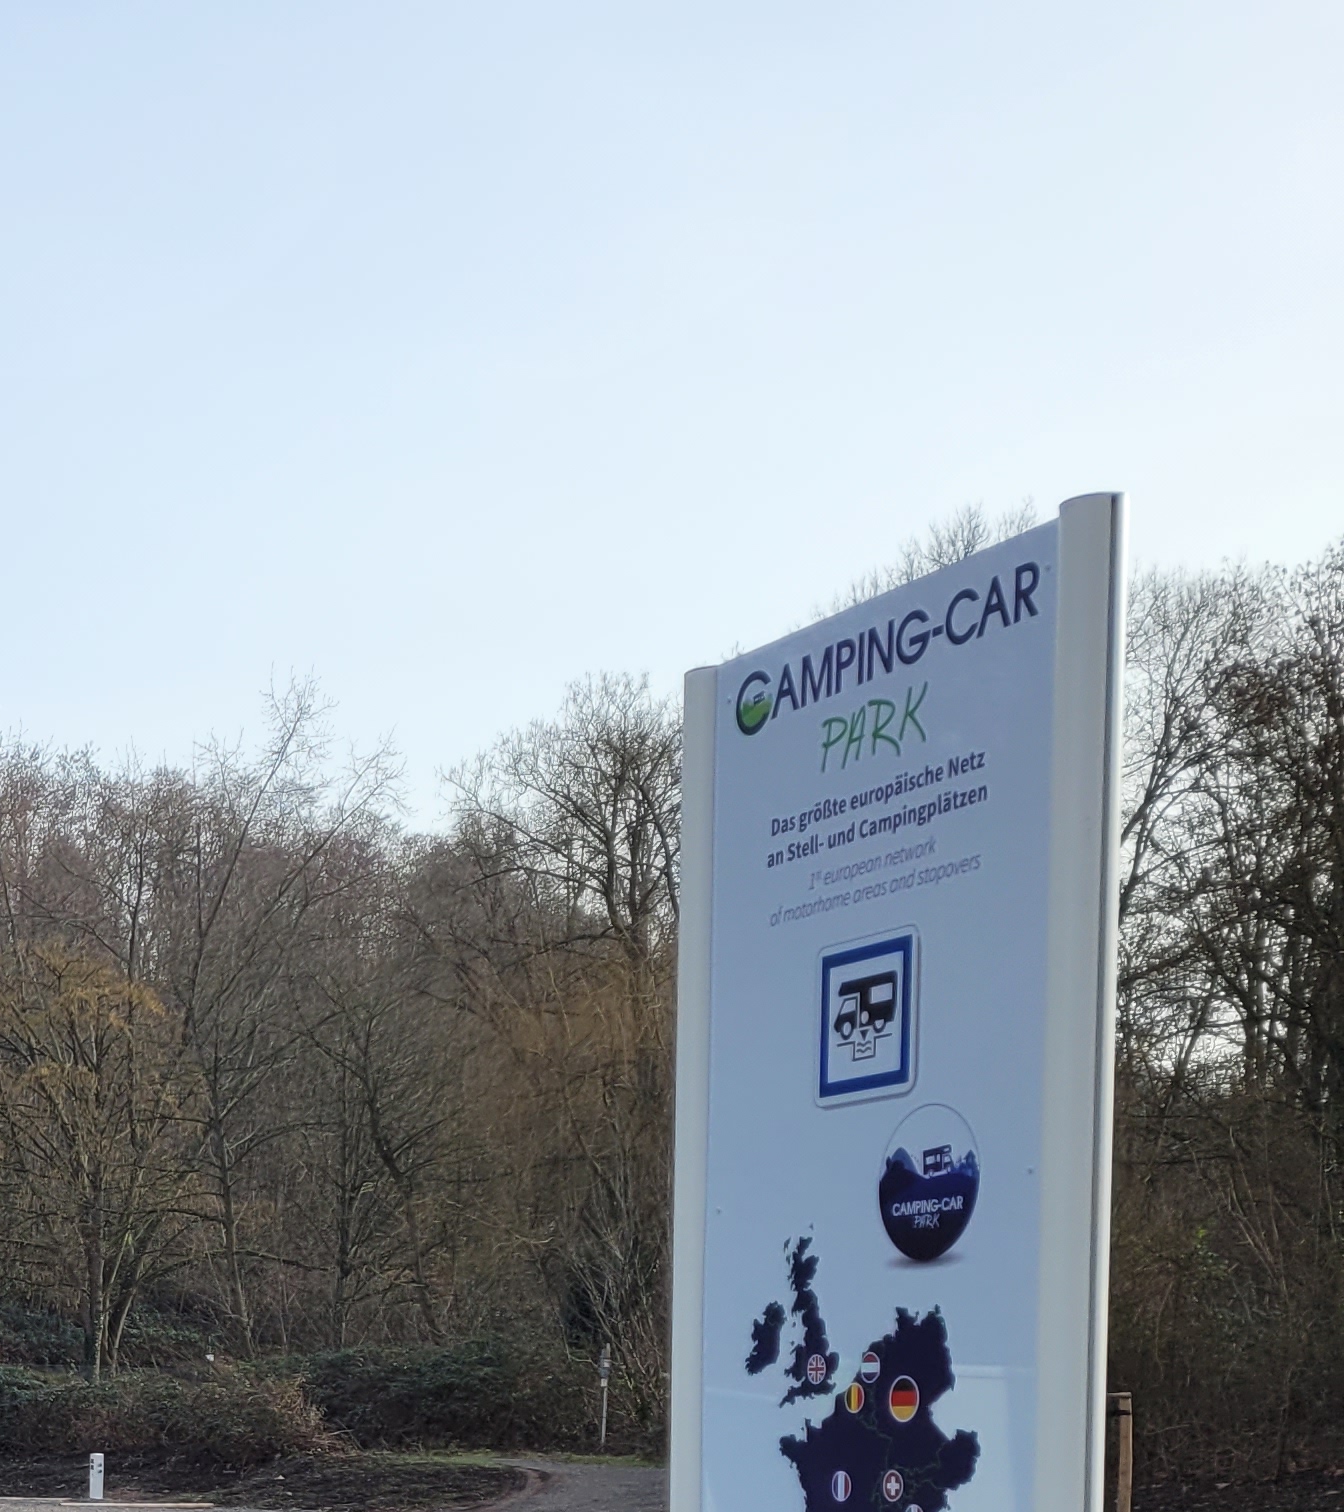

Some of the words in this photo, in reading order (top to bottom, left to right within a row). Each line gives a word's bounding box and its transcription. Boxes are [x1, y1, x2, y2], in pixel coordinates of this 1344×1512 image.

[736, 561, 1040, 735] CAMPING-CAR
[821, 681, 928, 772] PARK
[767, 850, 783, 868] an
[788, 834, 824, 862] Stell-
[828, 822, 855, 849] und
[859, 785, 988, 838] Campingplätzen
[771, 818, 795, 836] Das
[799, 799, 847, 832] größte
[850, 766, 943, 810] europäische
[948, 751, 985, 778] Netz
[770, 905, 783, 927] of
[783, 892, 850, 922] motorhome
[853, 880, 887, 903] areas
[889, 869, 915, 893] and
[917, 853, 981, 886] stopovers
[824, 855, 882, 886] european
[885, 835, 936, 868] network
[892, 1195, 964, 1216] CAMPING-CAR
[913, 1213, 940, 1229] PARK
